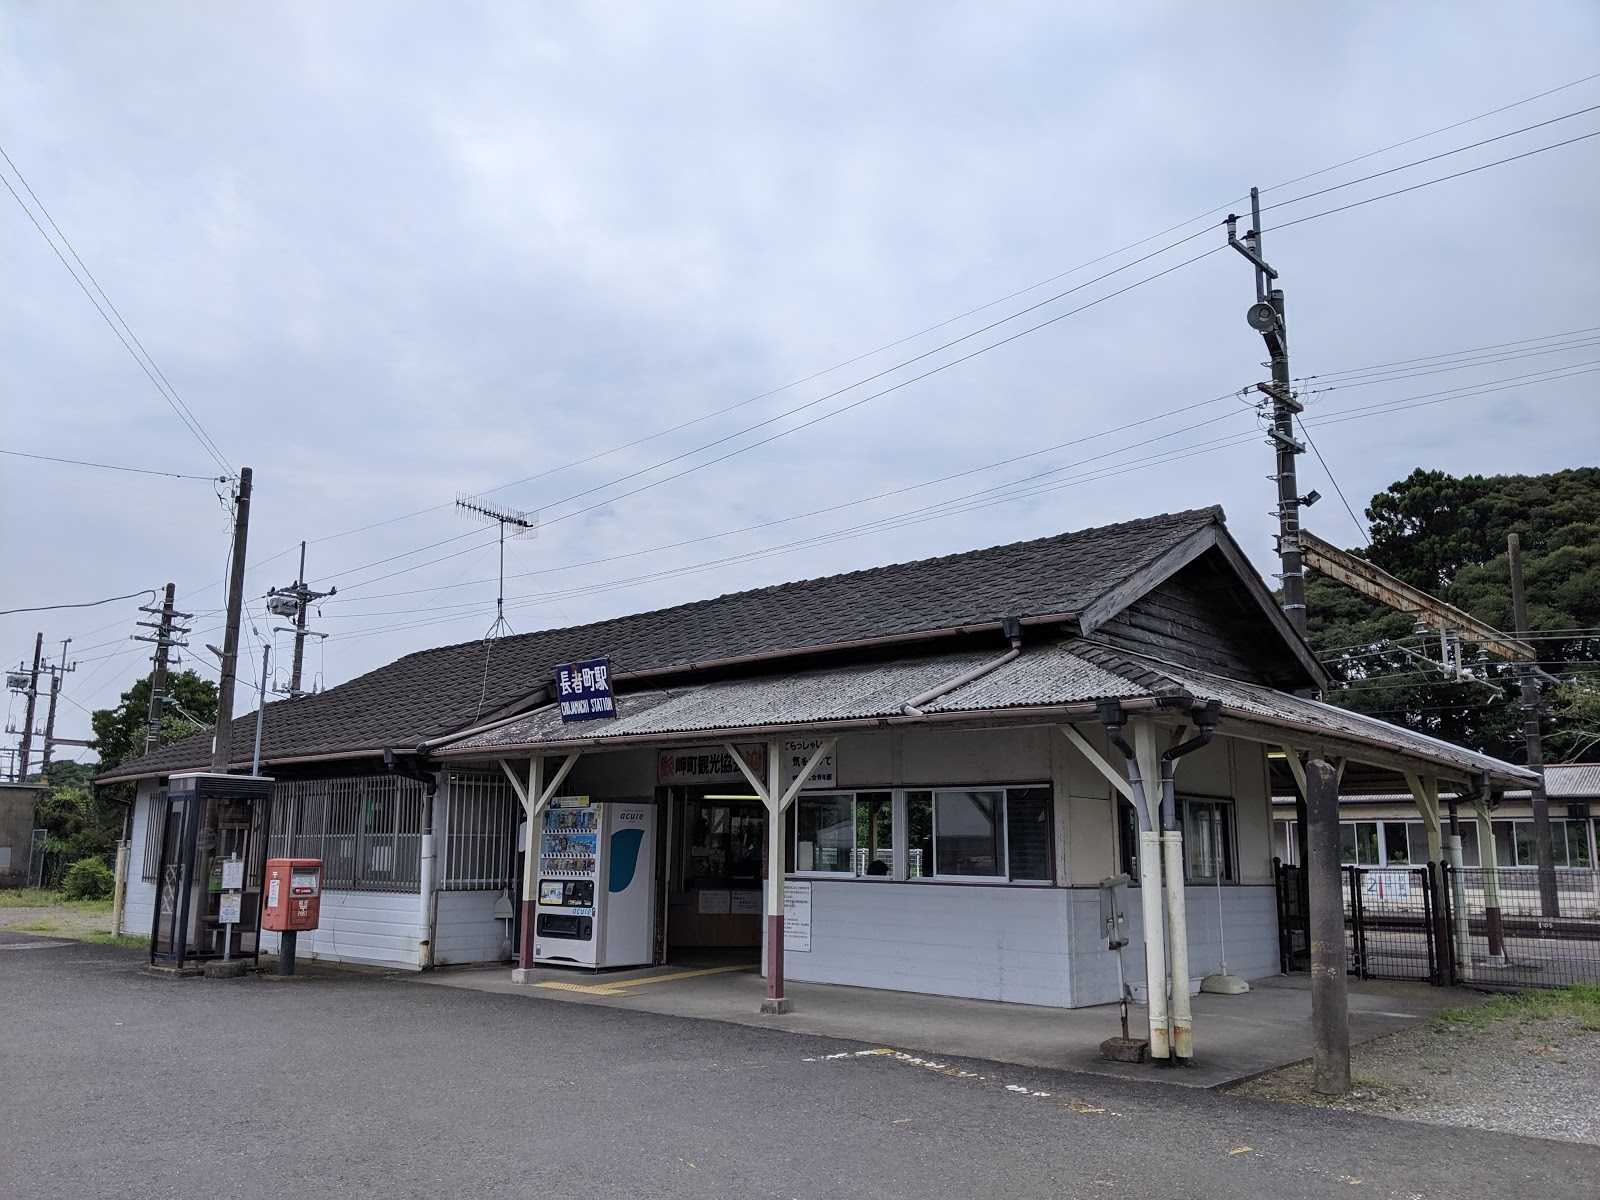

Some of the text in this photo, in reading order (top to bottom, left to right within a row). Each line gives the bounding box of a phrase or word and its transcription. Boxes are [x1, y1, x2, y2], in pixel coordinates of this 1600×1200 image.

[560, 665, 609, 695] 長者町駅
[590, 697, 613, 713] STATION
